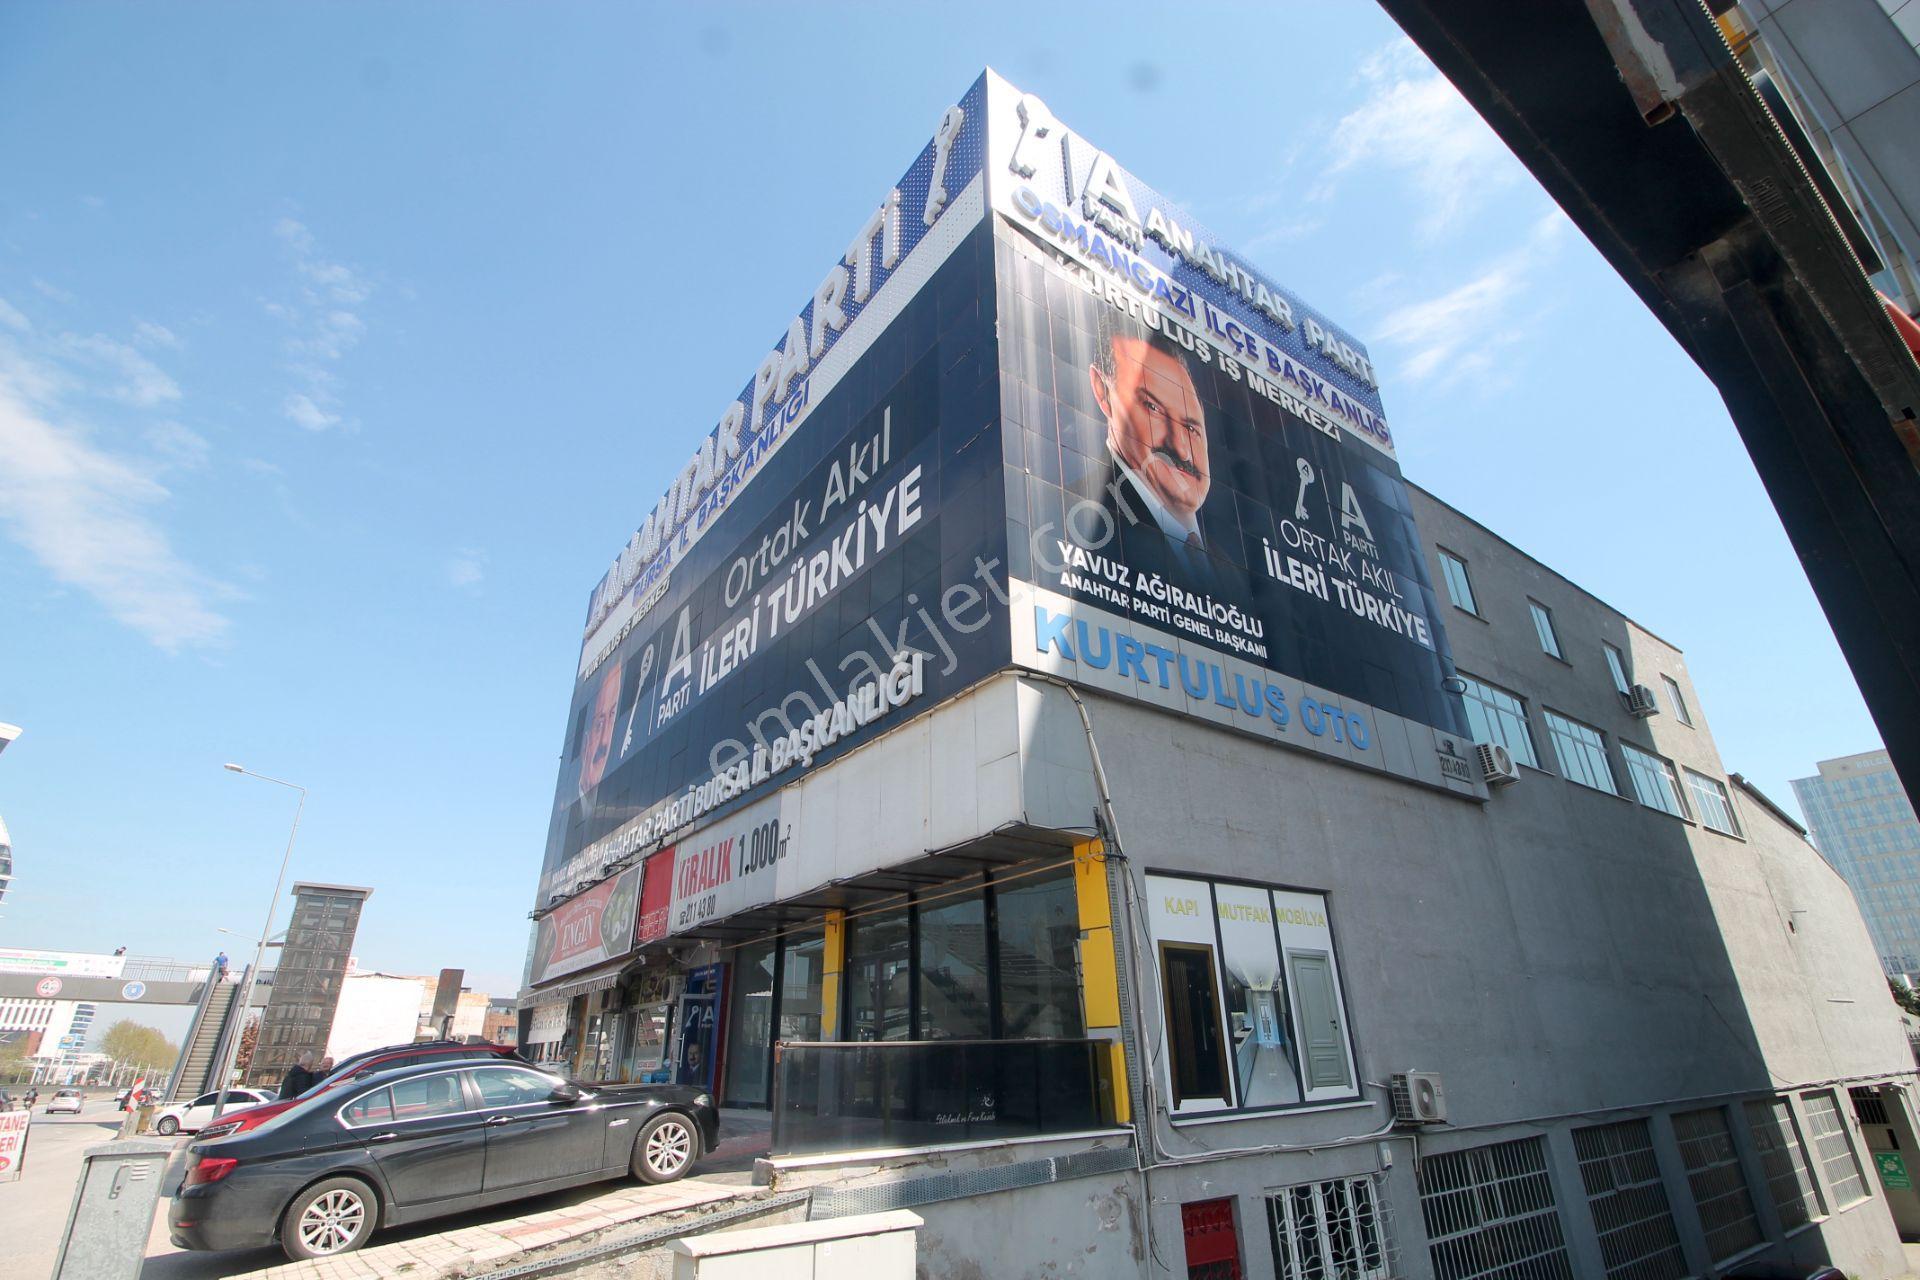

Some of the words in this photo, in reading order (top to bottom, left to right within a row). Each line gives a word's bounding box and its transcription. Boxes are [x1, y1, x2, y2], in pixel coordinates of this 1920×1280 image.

[1084, 150, 1142, 228] A
[750, 186, 900, 433] PARTİ
[1011, 186, 1197, 322] OSMANGAZİ
[1203, 300, 1260, 363] İLÇE
[1143, 207, 1295, 332] ANAHTAR
[1218, 351, 1242, 382] İŞ
[1246, 368, 1342, 443] MERKEZİ
[724, 498, 811, 609] Ortak
[819, 405, 891, 525] Akıl
[1341, 481, 1375, 542] A
[699, 594, 760, 696] İLERİ
[768, 463, 922, 639] TÜRKİYE
[1057, 540, 1131, 588] YAVUZ
[1135, 572, 1264, 638] AĞIRALİOĞLU
[1060, 571, 1130, 609] ANAHTAR
[1133, 597, 1170, 624] PARTİ
[1173, 613, 1214, 640] GENEL
[1262, 537, 1330, 602] İLERİ
[1331, 576, 1430, 647] TÜRKİYE
[1280, 519, 1358, 578] ORTAK
[1361, 558, 1404, 599] AKIL
[661, 604, 692, 699] A
[1033, 605, 1291, 731] KURTULUŞ
[1299, 696, 1370, 750] OTO
[657, 681, 691, 729] PARTİ
[693, 757, 751, 818] BURSA
[771, 650, 923, 775] BAŞKANLIĞI
[1164, 896, 1200, 917] KAPI
[1218, 903, 1271, 924] MUTFAK
[1276, 906, 1327, 928] MOBİLYA
